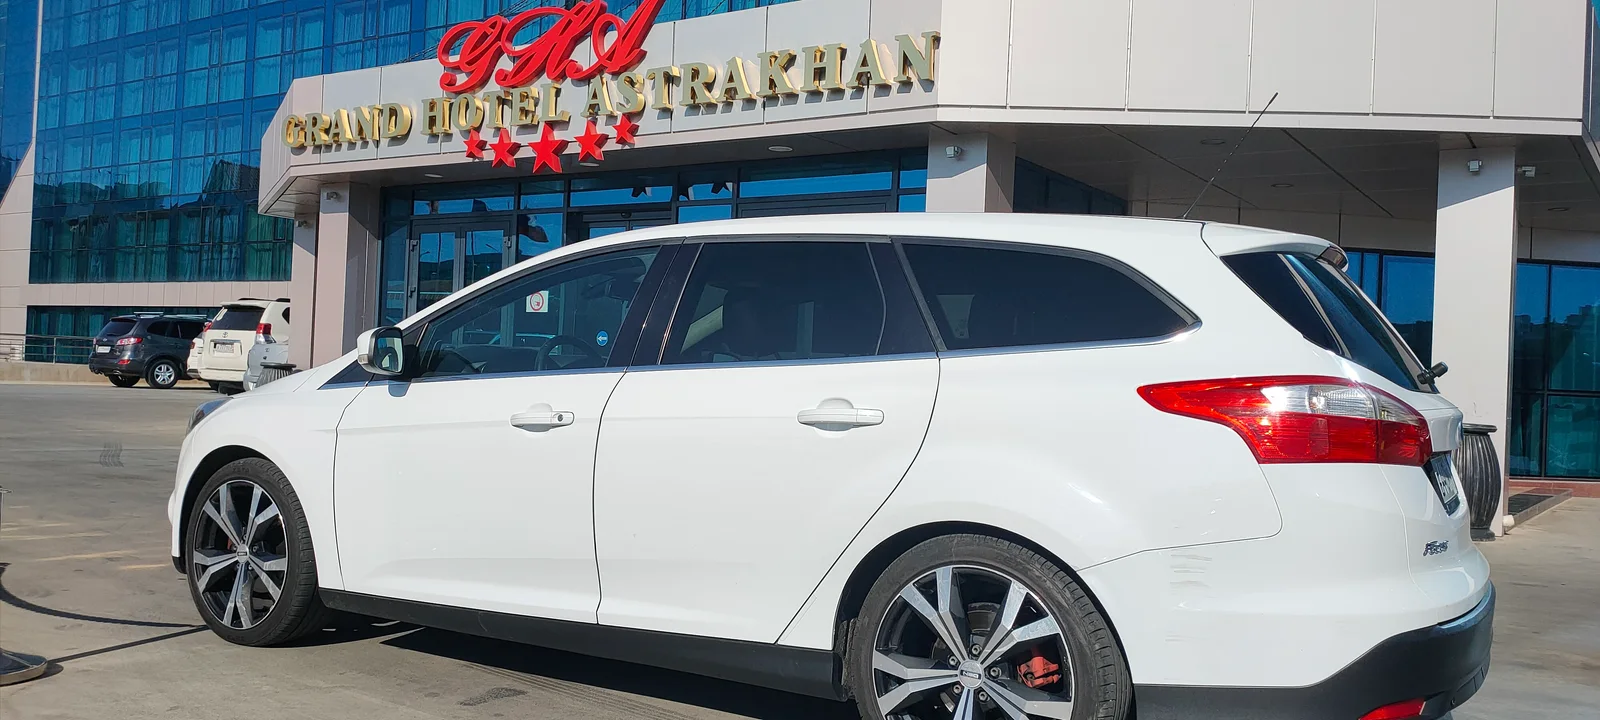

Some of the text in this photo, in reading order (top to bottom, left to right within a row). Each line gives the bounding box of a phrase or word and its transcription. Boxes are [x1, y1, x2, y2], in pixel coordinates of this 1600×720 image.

[281, 30, 941, 148] GRAND HOTEL ASTRAKHAN
